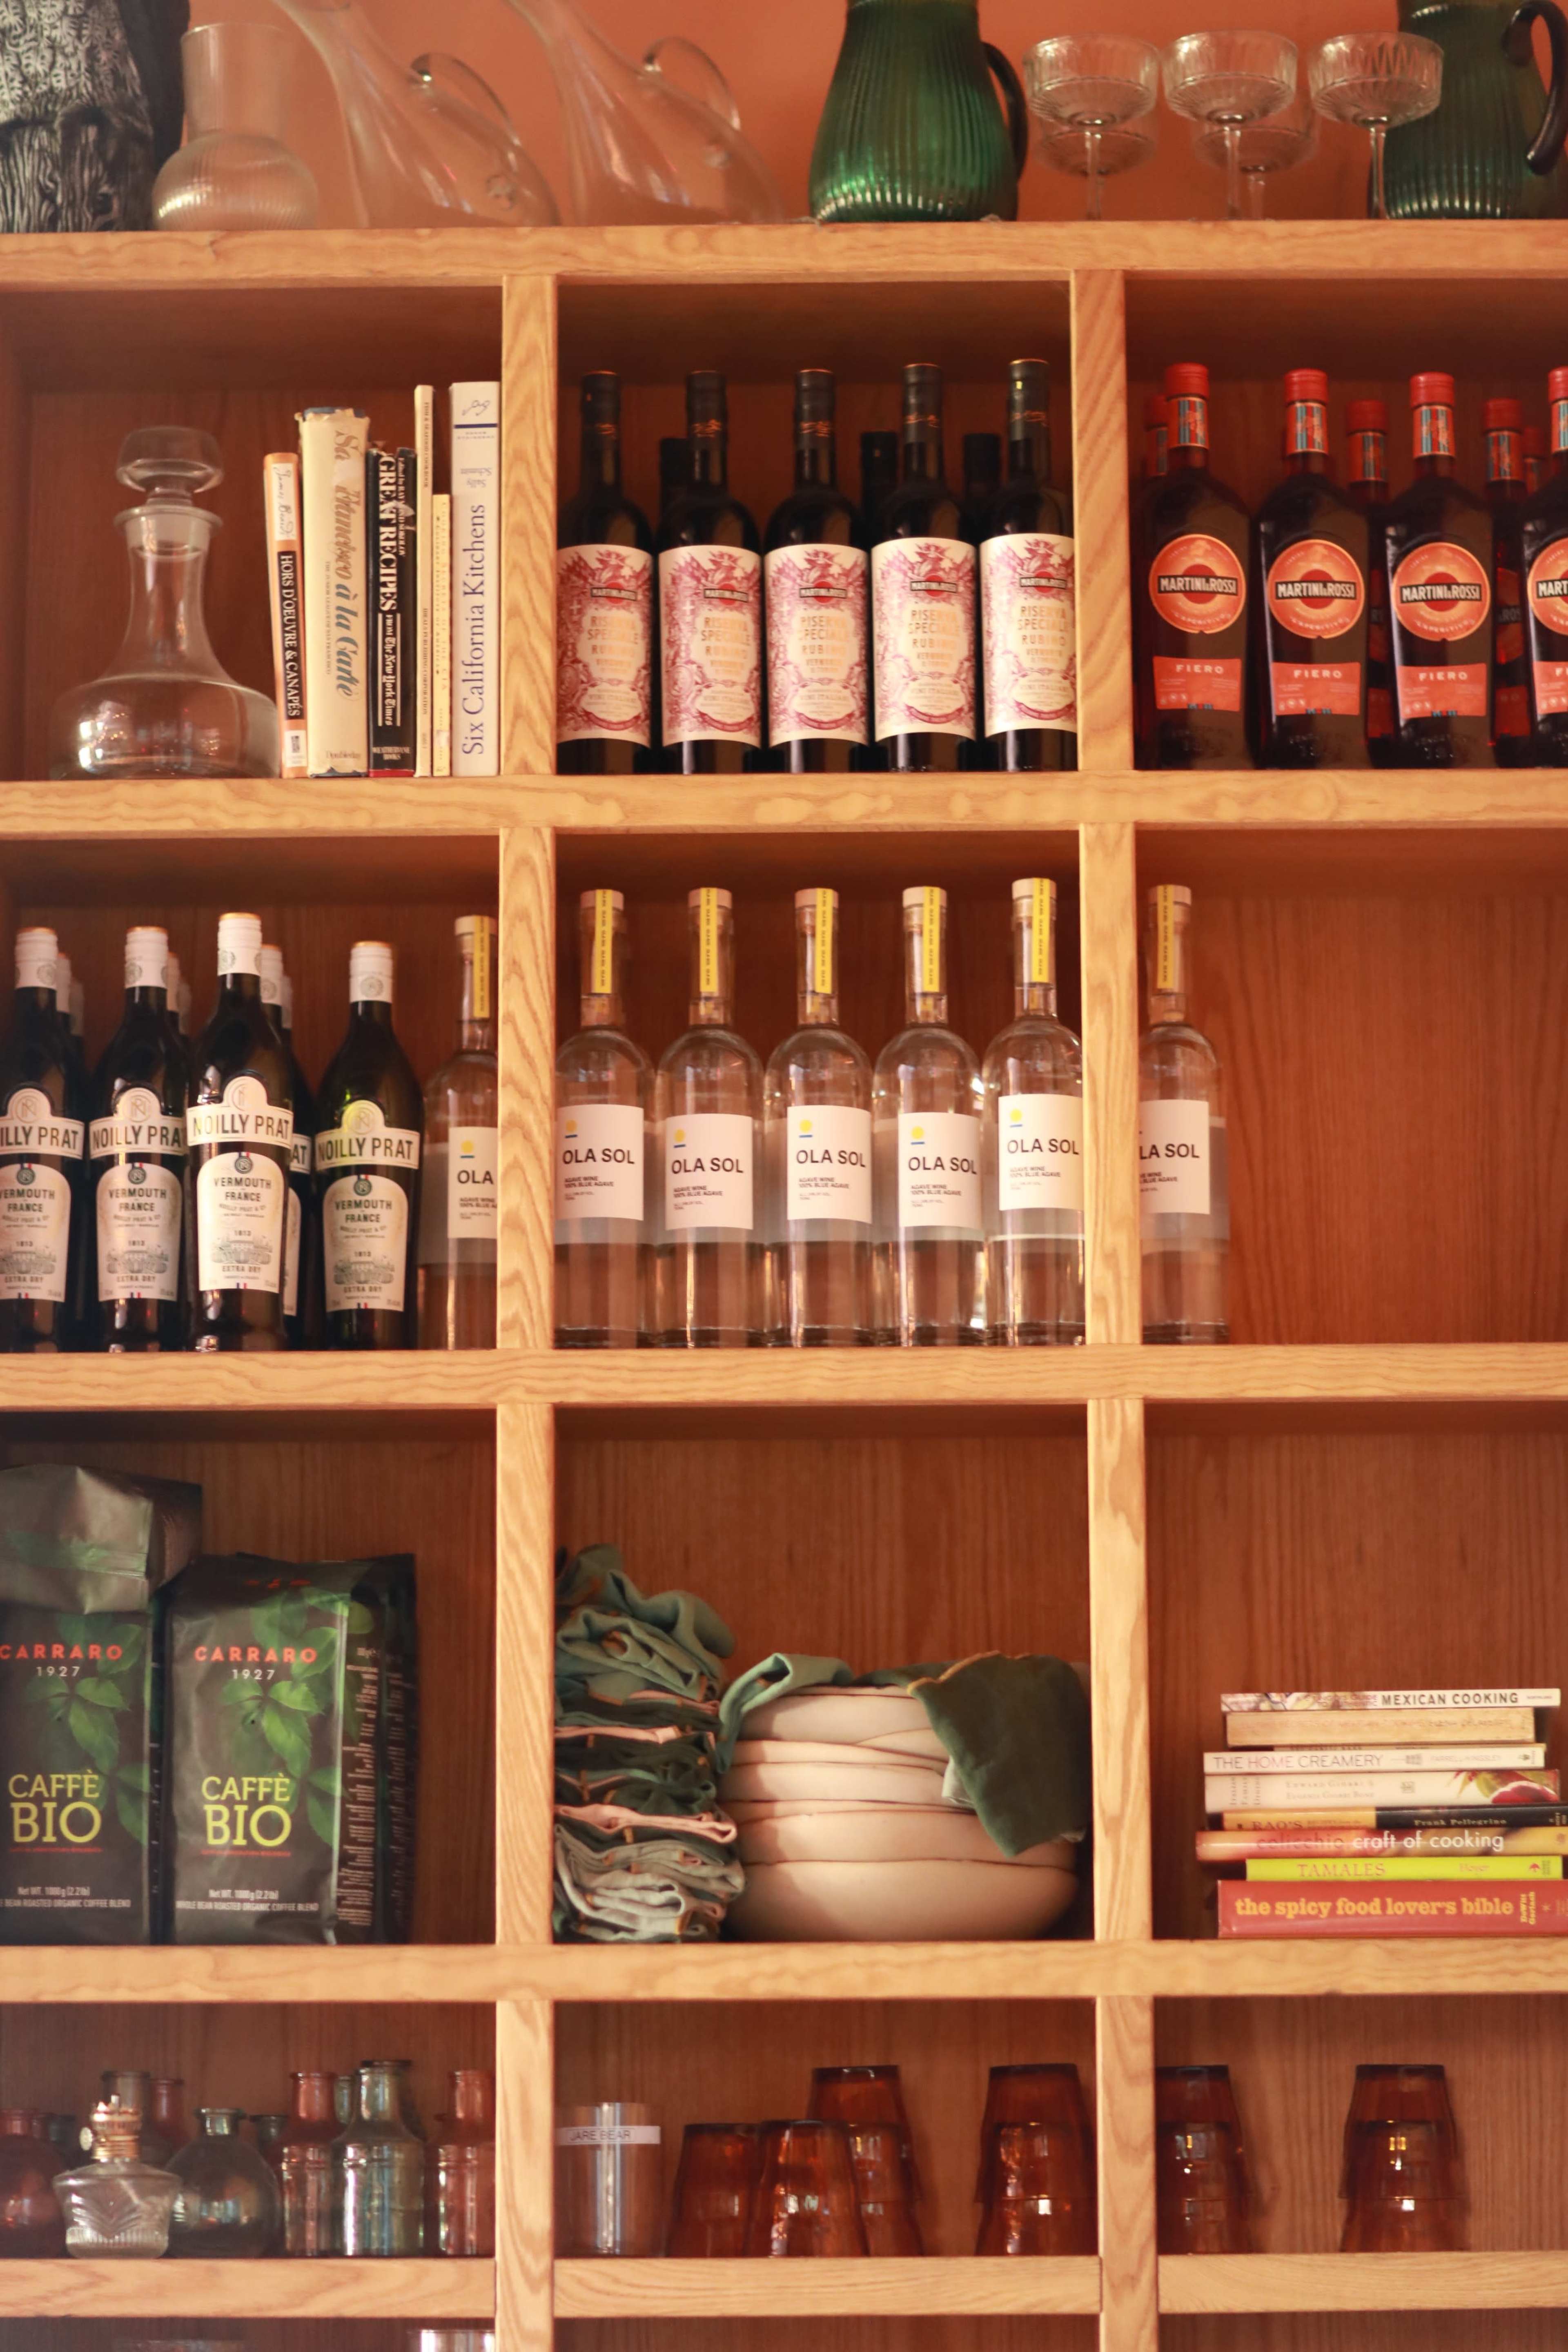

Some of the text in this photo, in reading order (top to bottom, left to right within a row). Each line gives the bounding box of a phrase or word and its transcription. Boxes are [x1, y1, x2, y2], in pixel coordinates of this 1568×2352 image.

[379, 456, 397, 611] GREAT RECIPES
[280, 555, 295, 587] HORS
[332, 429, 361, 699] Sa Francisco à la Carte
[281, 589, 298, 648] D'OEUVRE
[461, 505, 485, 755] Six California Kitchens
[385, 637, 396, 653] The
[284, 650, 297, 660] &
[385, 654, 395, 674] New
[1176, 664, 1224, 674] FIERO
[1294, 669, 1342, 679] FIERO
[1419, 671, 1468, 681] FIERO
[285, 661, 303, 717] CANAPÉS
[382, 675, 396, 697] York
[385, 698, 396, 726] Times
[193, 1114, 290, 1140] NOILLY PRAT
[38, 1126, 78, 1150] PRAT
[93, 1125, 143, 1148] NOILLY
[318, 1137, 413, 1162] NOILLY PRAT
[1007, 1138, 1080, 1155] OLA SOL
[1165, 1144, 1200, 1159] SOL
[563, 1148, 636, 1165] OLA SOL
[796, 1149, 866, 1168] OLA SOL
[908, 1156, 978, 1174] OLA SOL
[671, 1157, 744, 1175] OLA SOL
[214, 1177, 272, 1189] VERMOUTH
[457, 1169, 494, 1185] OLA
[108, 1188, 167, 1199] VERMOUTH
[225, 1192, 261, 1202] FRANCE
[8, 1203, 43, 1213] FRANCE
[119, 1202, 155, 1212] FRANCE
[334, 1199, 392, 1210] VERMOUTH
[345, 1214, 380, 1223] FRANCE
[0, 1643, 123, 1660] CARRARO
[194, 1646, 318, 1664] CARRARO
[37, 1666, 80, 1677] 1927
[231, 1668, 275, 1680] 1927
[1381, 1693, 1447, 1706] MEXICAN
[1452, 1692, 1519, 1705] COOKING
[1214, 1755, 1383, 1769] THE HOME CREAMERY
[8, 1769, 100, 1799] CAFFÈ
[201, 1773, 291, 1802] CAFFÈ
[9, 1801, 102, 1844] BIO
[203, 1804, 292, 1847] BIO
[1256, 1829, 1504, 1852] colicchio craft of cooking
[1297, 1863, 1385, 1878] TAMALES
[1235, 1897, 1514, 1920] the spicy food lover's bible
